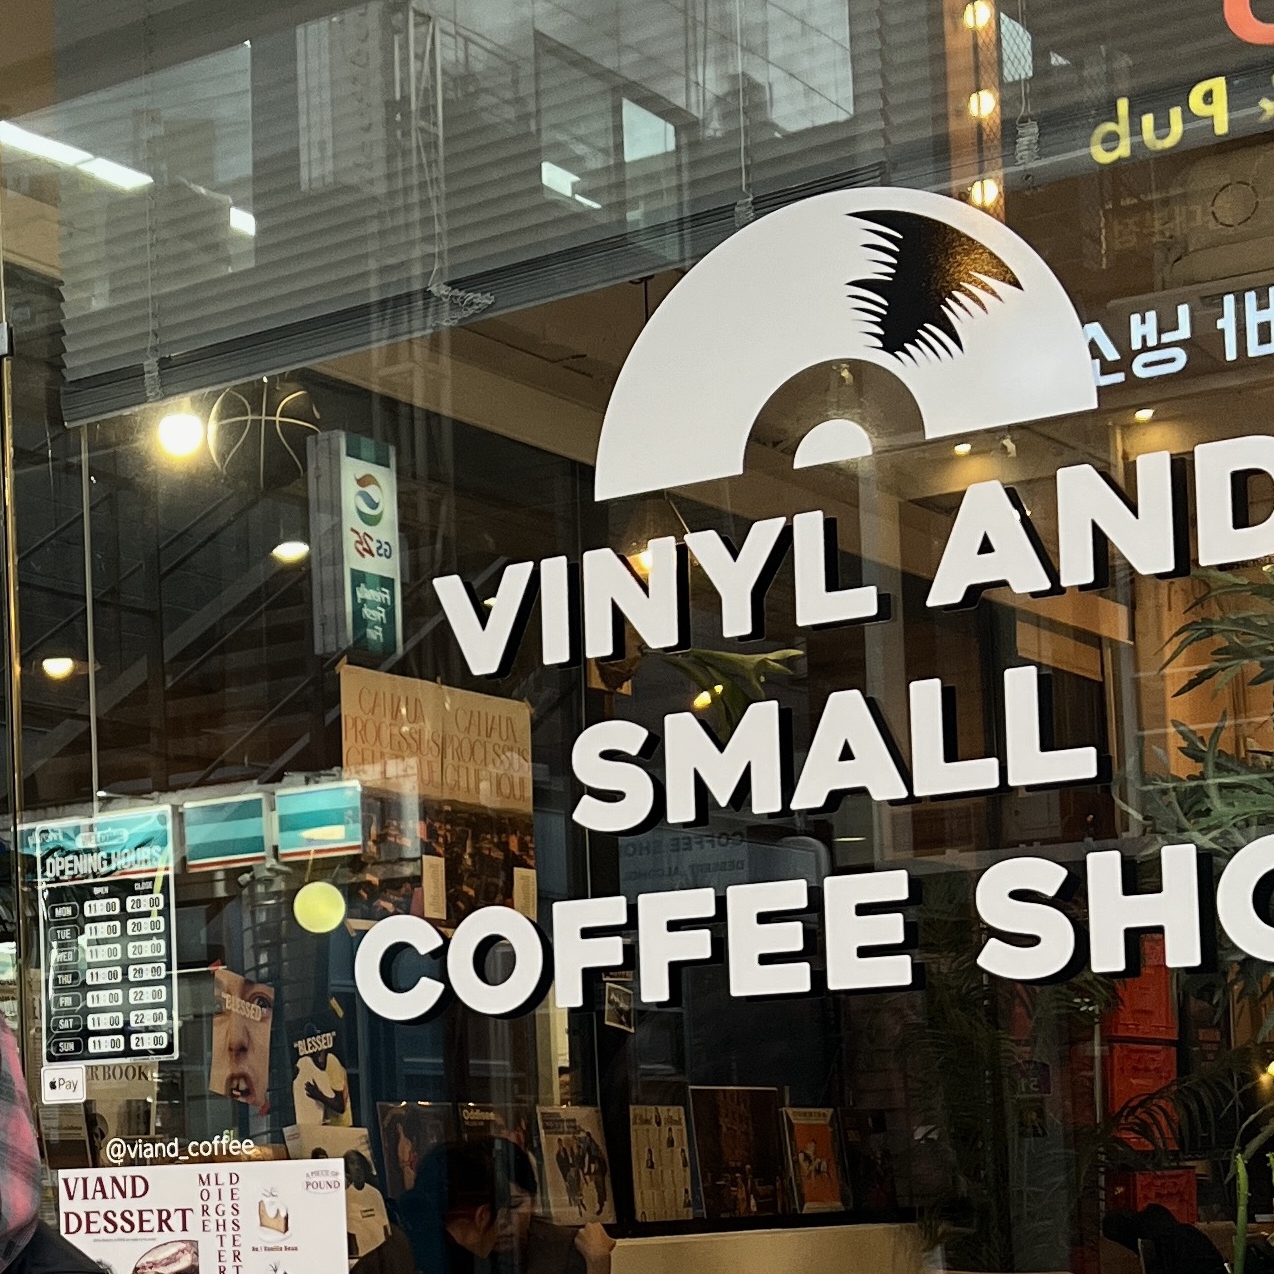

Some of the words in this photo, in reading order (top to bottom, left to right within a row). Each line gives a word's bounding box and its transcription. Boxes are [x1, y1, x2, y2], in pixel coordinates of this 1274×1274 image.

[432, 510, 879, 677] VINYL
[926, 435, 1274, 608] AND
[571, 666, 1098, 833] SMALL
[46, 851, 108, 878] OPENING
[109, 845, 162, 870] HOURS
[56, 928, 71, 940] TUE
[353, 869, 913, 1021] COFFEE
[58, 1018, 73, 1030] SAT
[58, 1078, 78, 1093] Pay
[106, 1136, 255, 1165] @viand_coffee
[61, 1174, 150, 1201] VIAND
[305, 1180, 341, 1190] POUND
[63, 1208, 194, 1236] DESSERT
